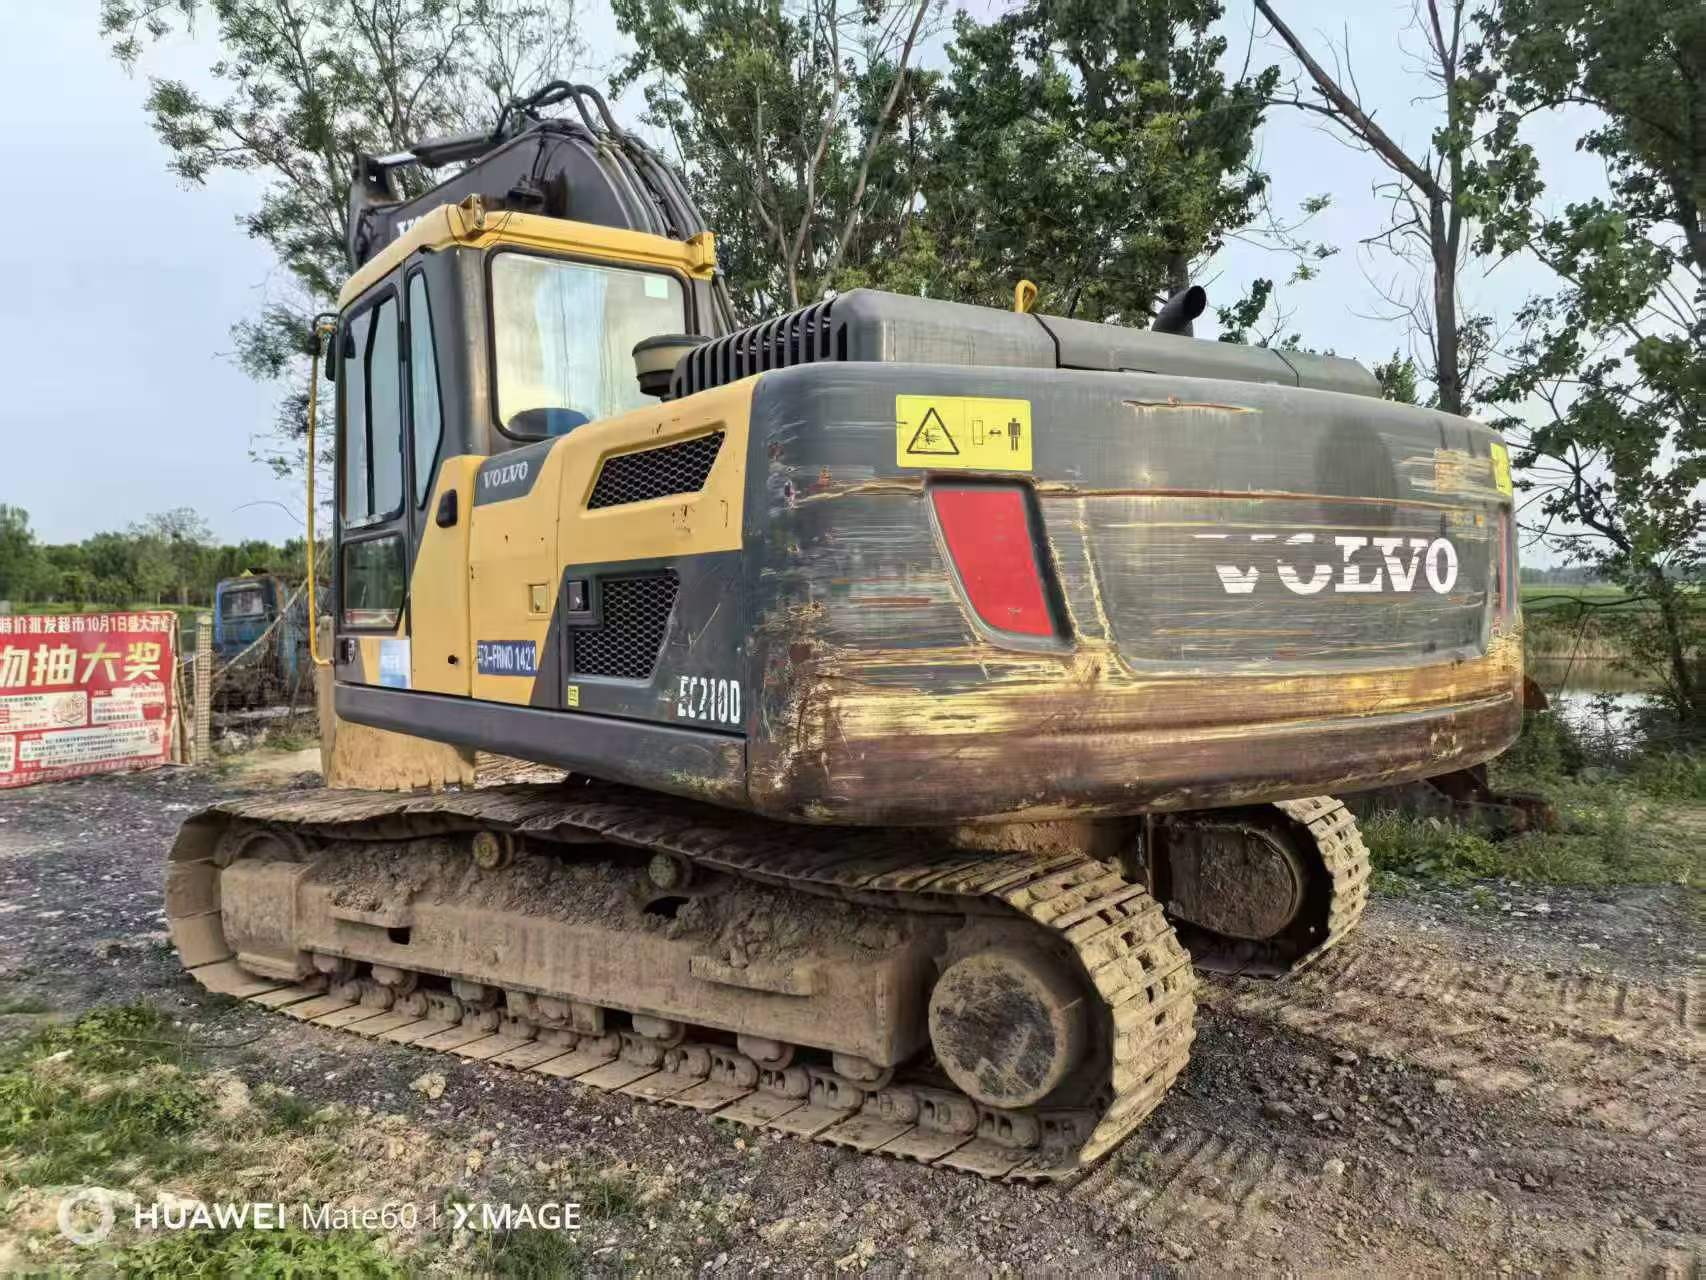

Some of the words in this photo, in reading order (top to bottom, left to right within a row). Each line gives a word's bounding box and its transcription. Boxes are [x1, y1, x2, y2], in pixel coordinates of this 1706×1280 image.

[484, 461, 528, 488] VOLVO
[1193, 533, 1458, 595] VOLVO
[677, 675, 741, 724] EC210D
